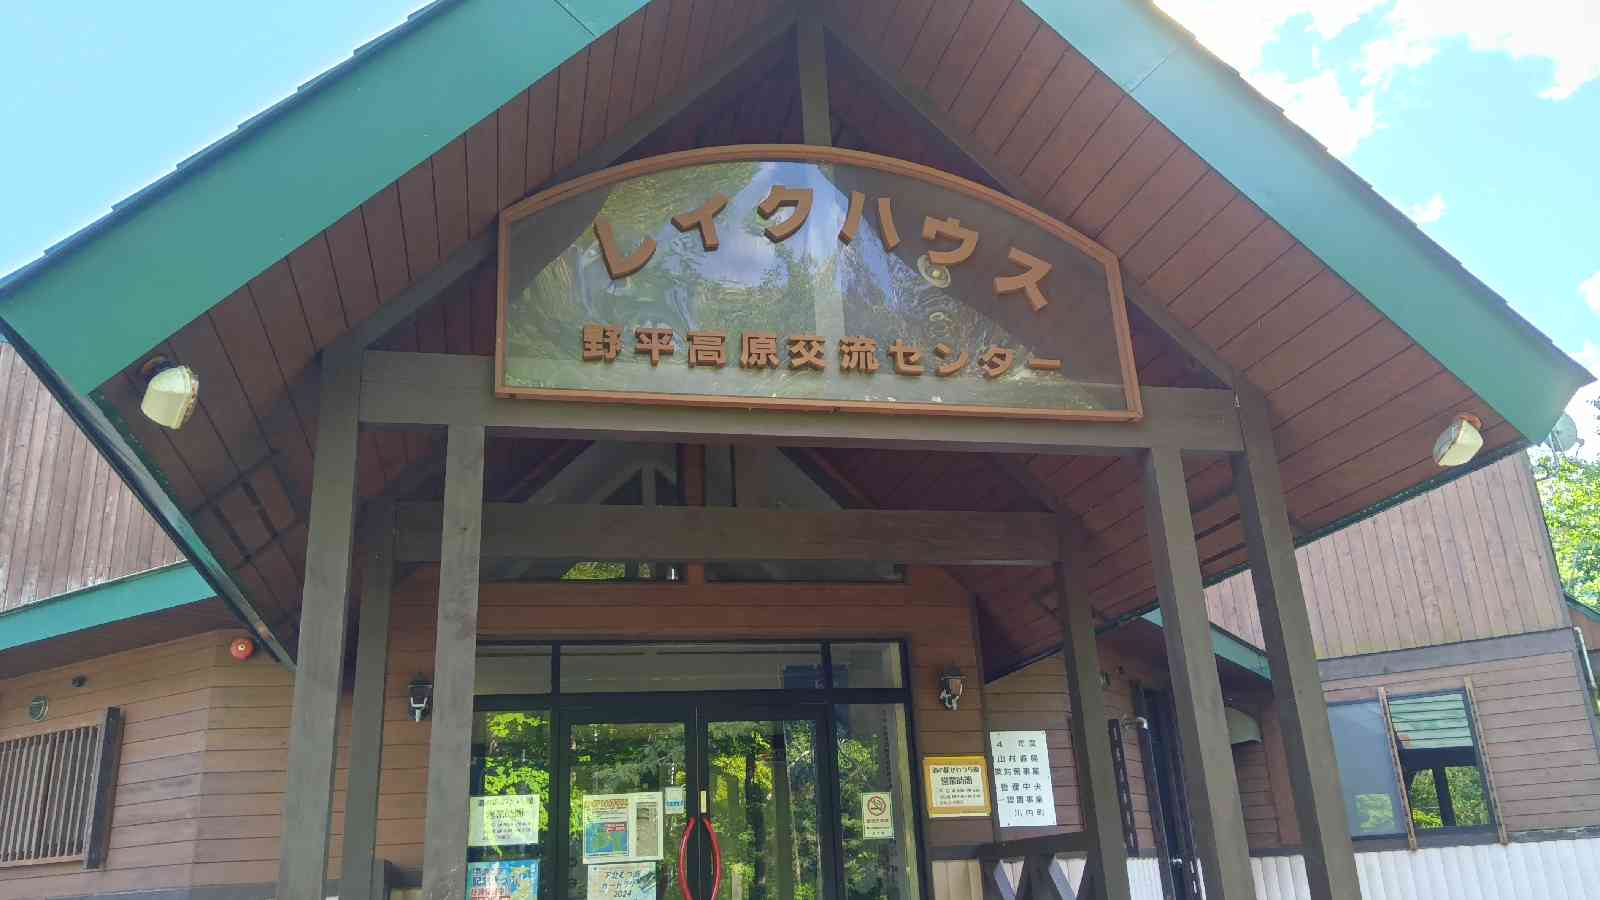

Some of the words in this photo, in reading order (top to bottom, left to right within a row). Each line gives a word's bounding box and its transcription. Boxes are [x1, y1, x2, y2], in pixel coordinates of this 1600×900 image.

[594, 186, 1054, 311] レイクハウス
[582, 324, 1061, 377] 野平高原交流センター
